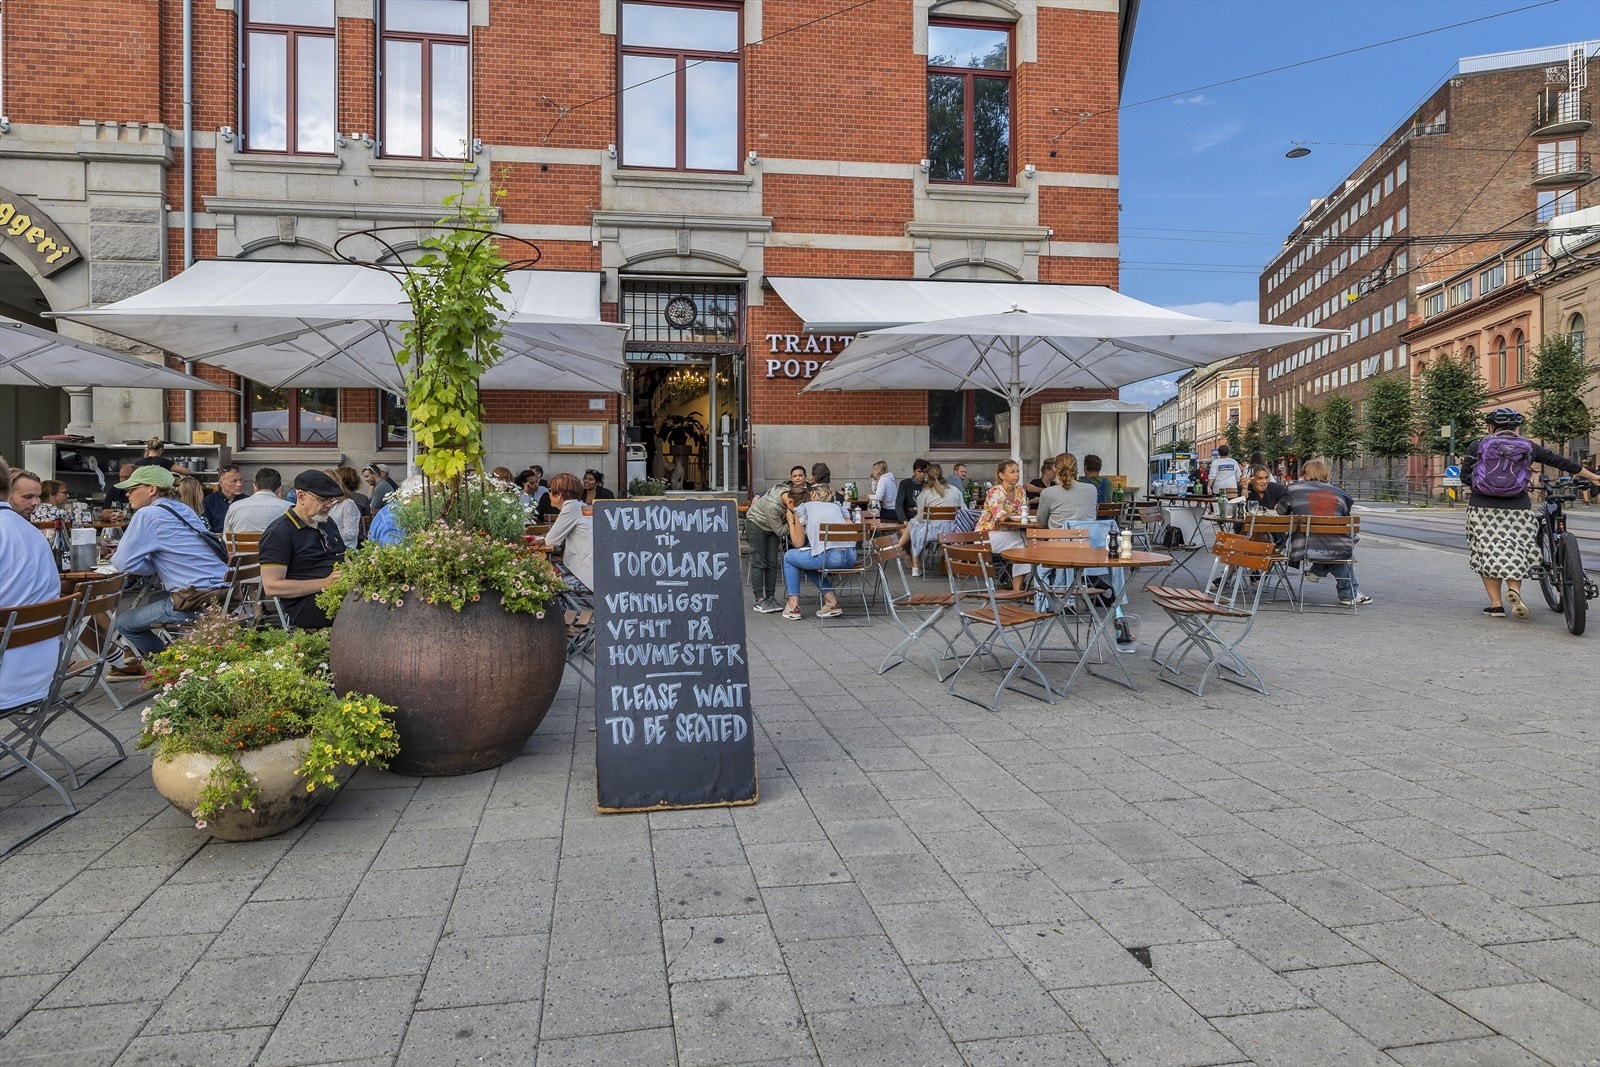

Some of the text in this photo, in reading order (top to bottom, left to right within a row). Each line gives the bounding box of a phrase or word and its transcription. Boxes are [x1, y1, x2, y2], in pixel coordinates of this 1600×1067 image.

[766, 359, 831, 379] POP
[603, 505, 729, 534] VELKOMMEN
[612, 550, 730, 580] POPOLARE
[606, 615, 714, 641] VENT PÅ
[607, 641, 745, 667] HOVMESTER
[610, 682, 682, 712] PLEASE
[604, 712, 748, 746] TO BE SEATED
